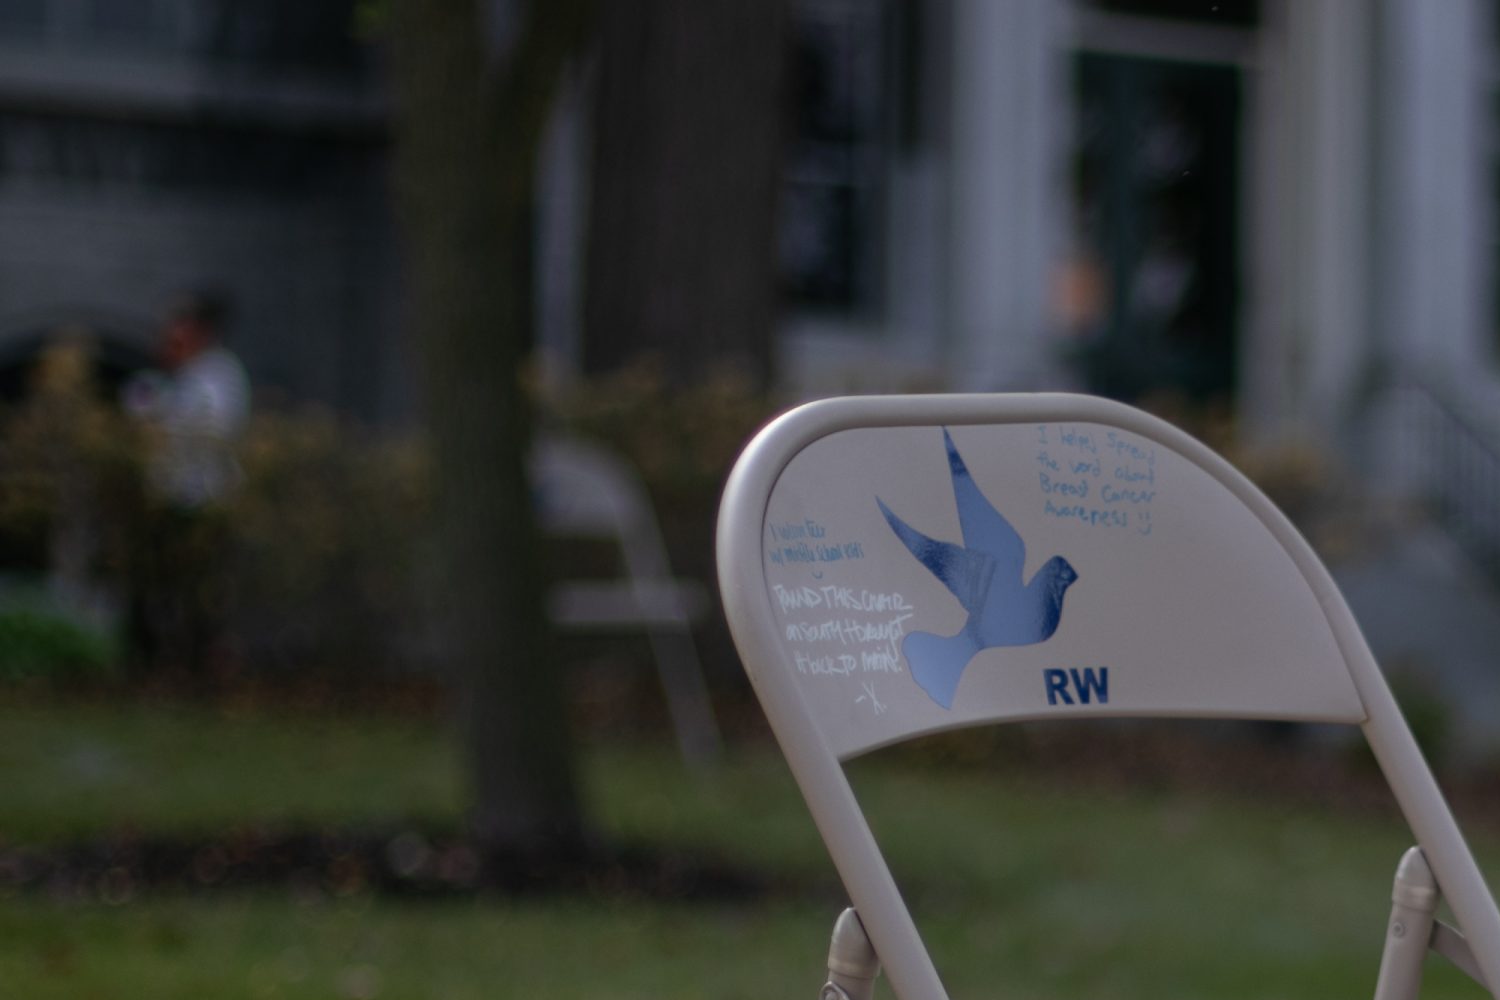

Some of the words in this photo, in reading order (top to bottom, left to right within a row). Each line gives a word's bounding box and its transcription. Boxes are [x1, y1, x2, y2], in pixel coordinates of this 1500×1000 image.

[1068, 458, 1101, 477] word
[1101, 484, 1156, 504] Cancer
[1042, 666, 1109, 705] RW
